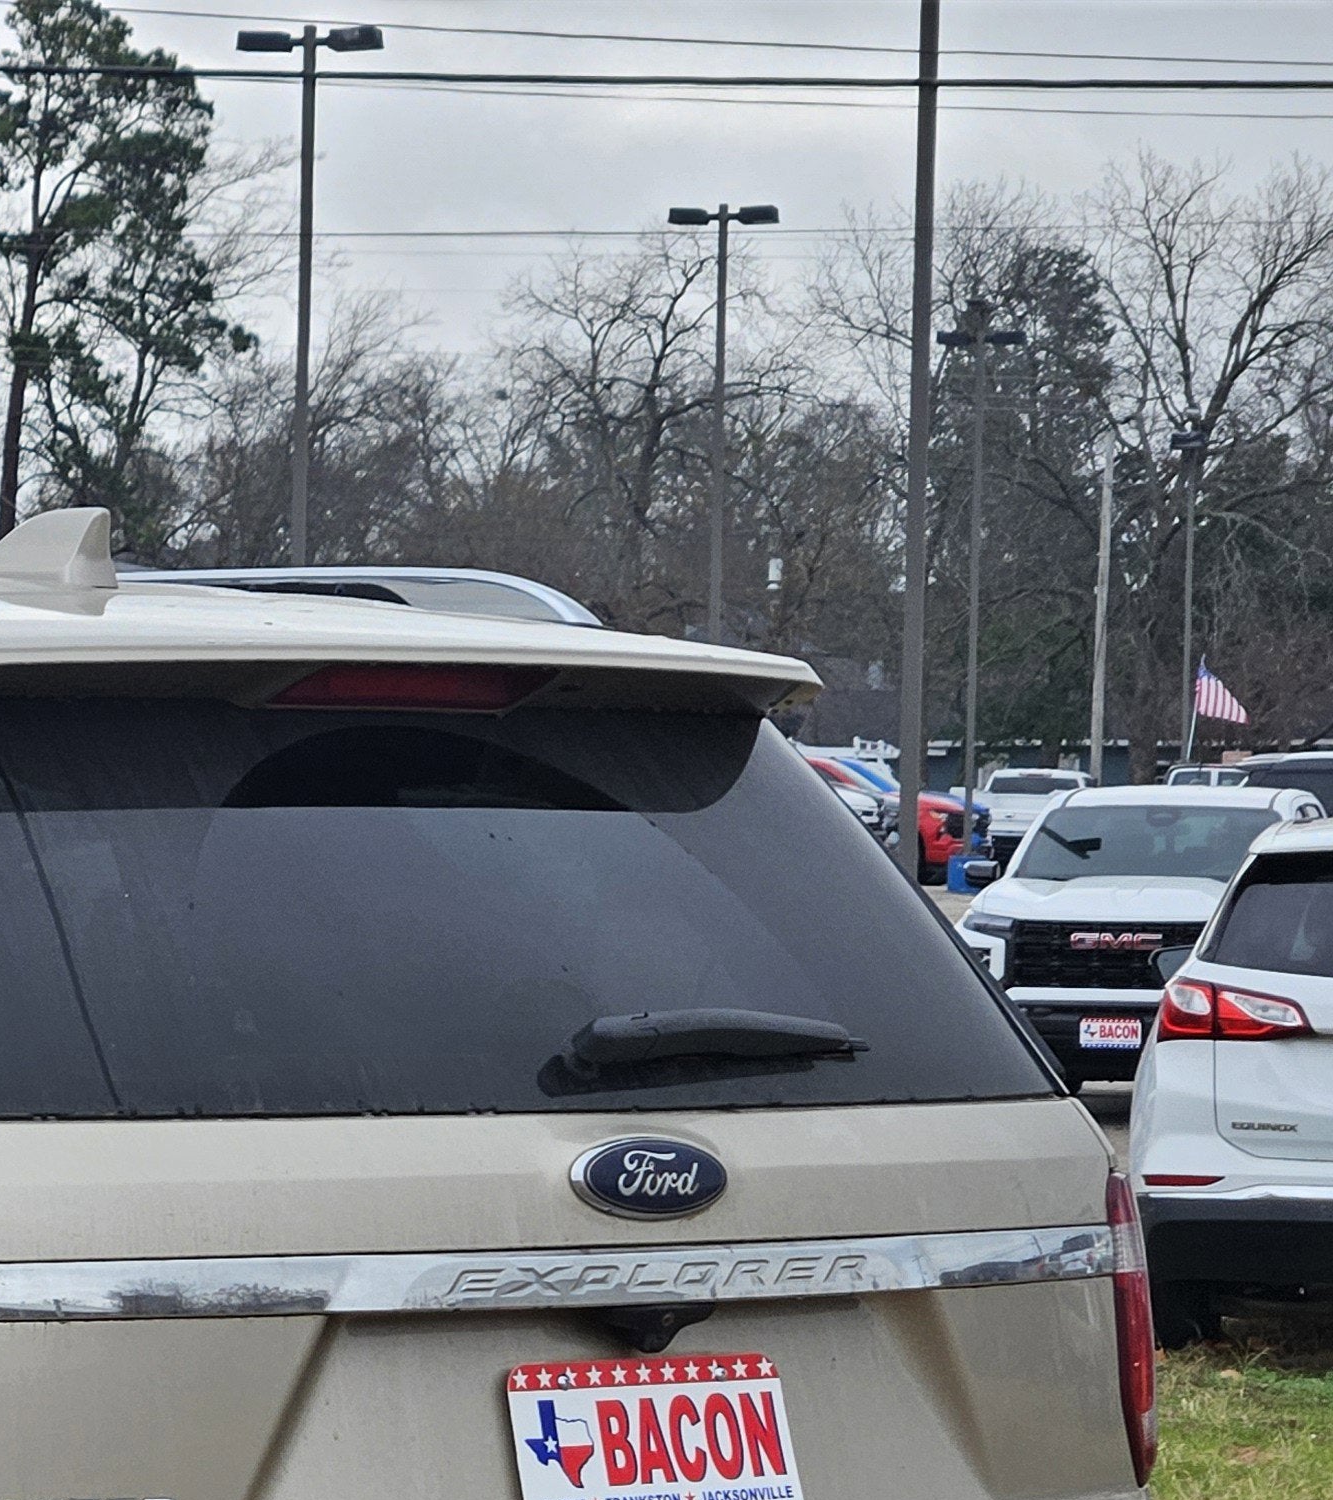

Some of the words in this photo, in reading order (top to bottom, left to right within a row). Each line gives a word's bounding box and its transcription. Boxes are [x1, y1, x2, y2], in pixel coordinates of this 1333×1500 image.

[1070, 932, 1163, 951] GMC
[1099, 1025, 1139, 1039] BACON
[1231, 1121, 1299, 1133] EQUINOX
[617, 1149, 700, 1197] Ford
[445, 1254, 869, 1298] EXPLORER
[595, 1391, 788, 1487] BACON
